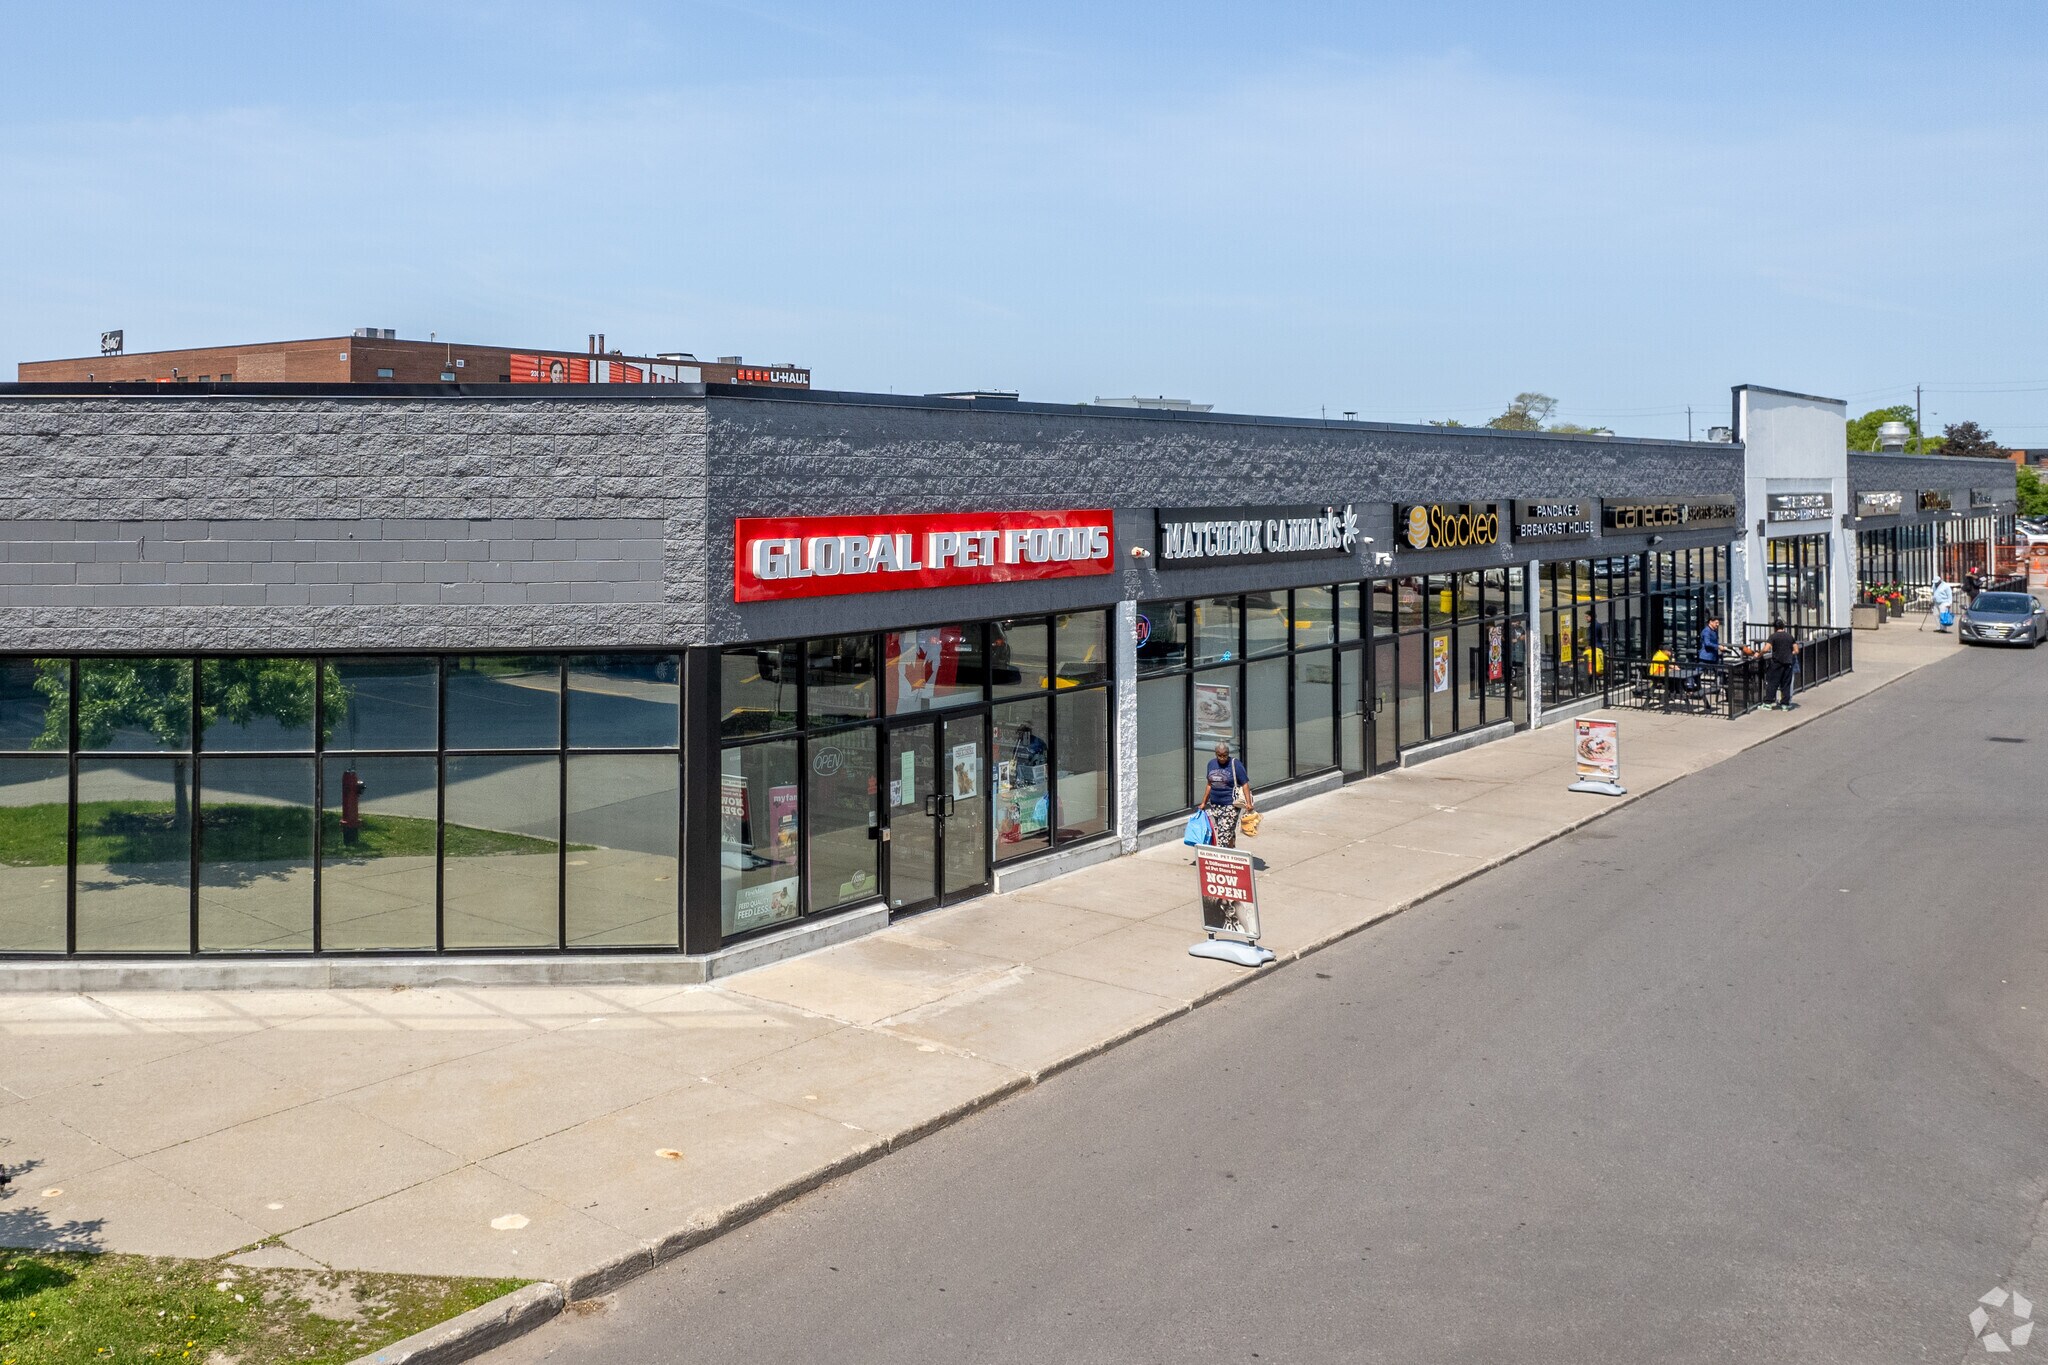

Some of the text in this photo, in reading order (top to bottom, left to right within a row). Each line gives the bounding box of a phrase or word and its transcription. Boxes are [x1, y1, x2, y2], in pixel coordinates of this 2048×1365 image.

[770, 371, 809, 384] U-HAUL
[1536, 505, 1580, 517] PANCAKE &
[1430, 504, 1499, 548] Stacked
[1520, 521, 1594, 537] BREAKFAST HOUSE
[1163, 519, 1263, 559] MATCHBOX
[753, 525, 1109, 580] GLOBAL PET FOODS
[1136, 622, 1149, 639] EN
[815, 754, 841, 769] OPEN
[1206, 872, 1238, 887] NOW
[1207, 884, 1247, 900] OPEN!
[738, 902, 750, 910] FEED
[737, 909, 753, 919] FEED
